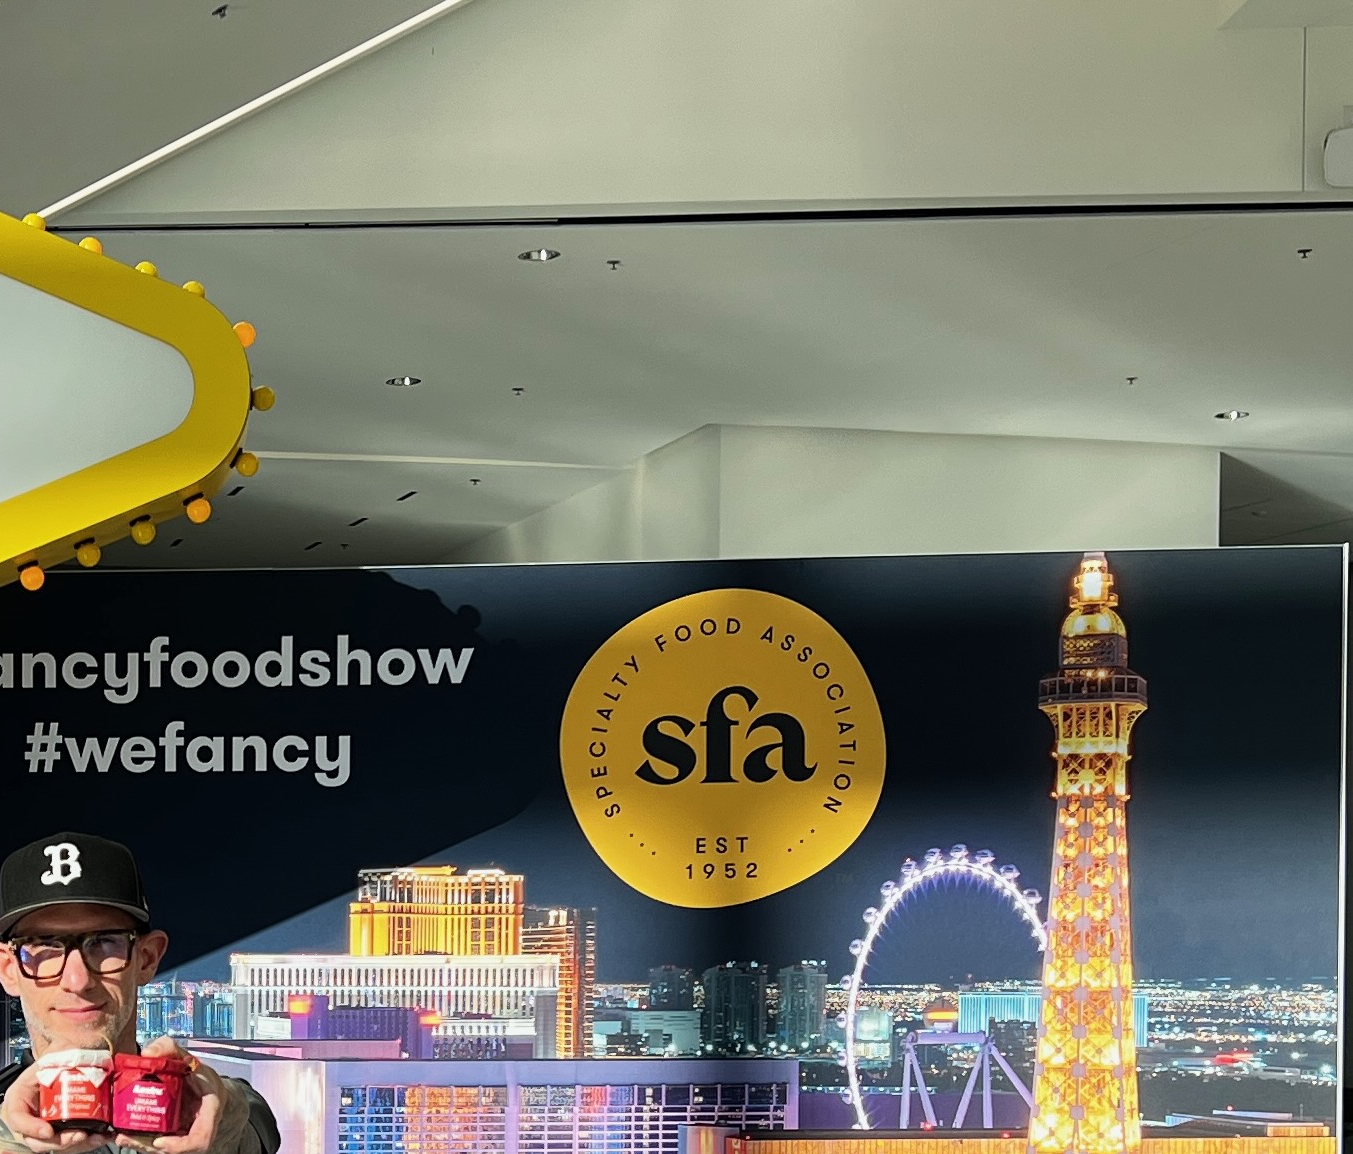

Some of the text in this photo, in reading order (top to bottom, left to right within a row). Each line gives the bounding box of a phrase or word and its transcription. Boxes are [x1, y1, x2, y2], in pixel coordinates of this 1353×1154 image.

[588, 618, 857, 818] SPECIALTY FOOD ASSOCIATION
[634, 685, 818, 786] sfa
[24, 721, 351, 788] #wefancy
[40, 842, 83, 886] B
[685, 863, 758, 880] 1952
[696, 837, 749, 854] EST
